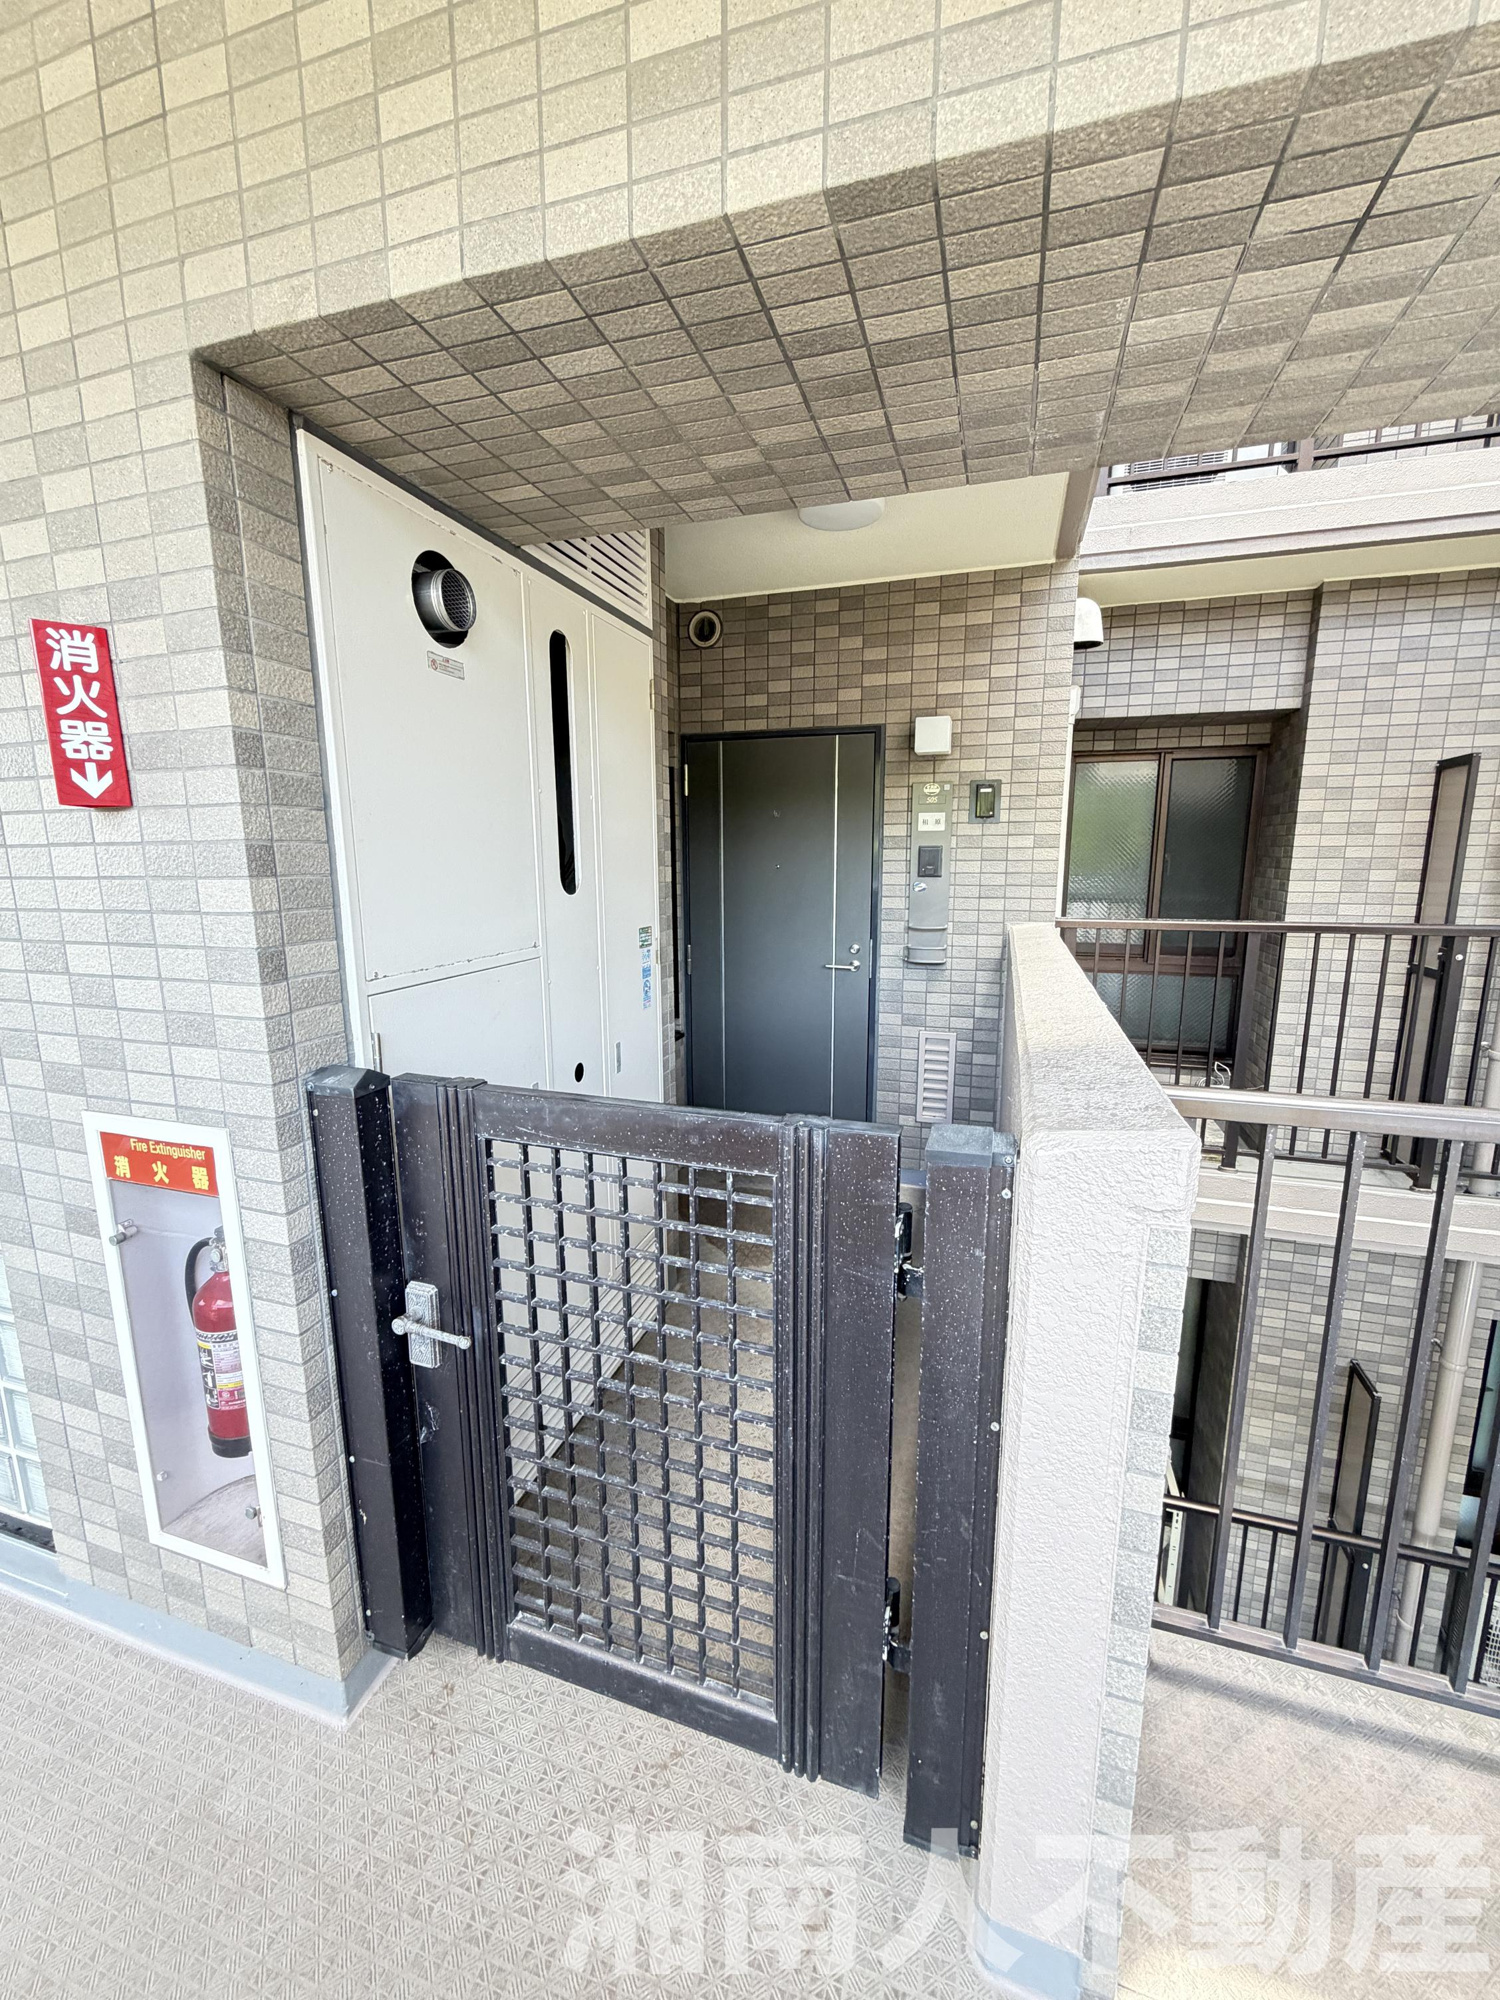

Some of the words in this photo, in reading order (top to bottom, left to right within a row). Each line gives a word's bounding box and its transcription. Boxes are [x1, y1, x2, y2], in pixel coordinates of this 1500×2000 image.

[45, 627, 114, 760] 消火器
[129, 1138, 148, 1153] Fire
[149, 1141, 206, 1160] Extinguisher
[113, 1155, 210, 1190] 消火器
